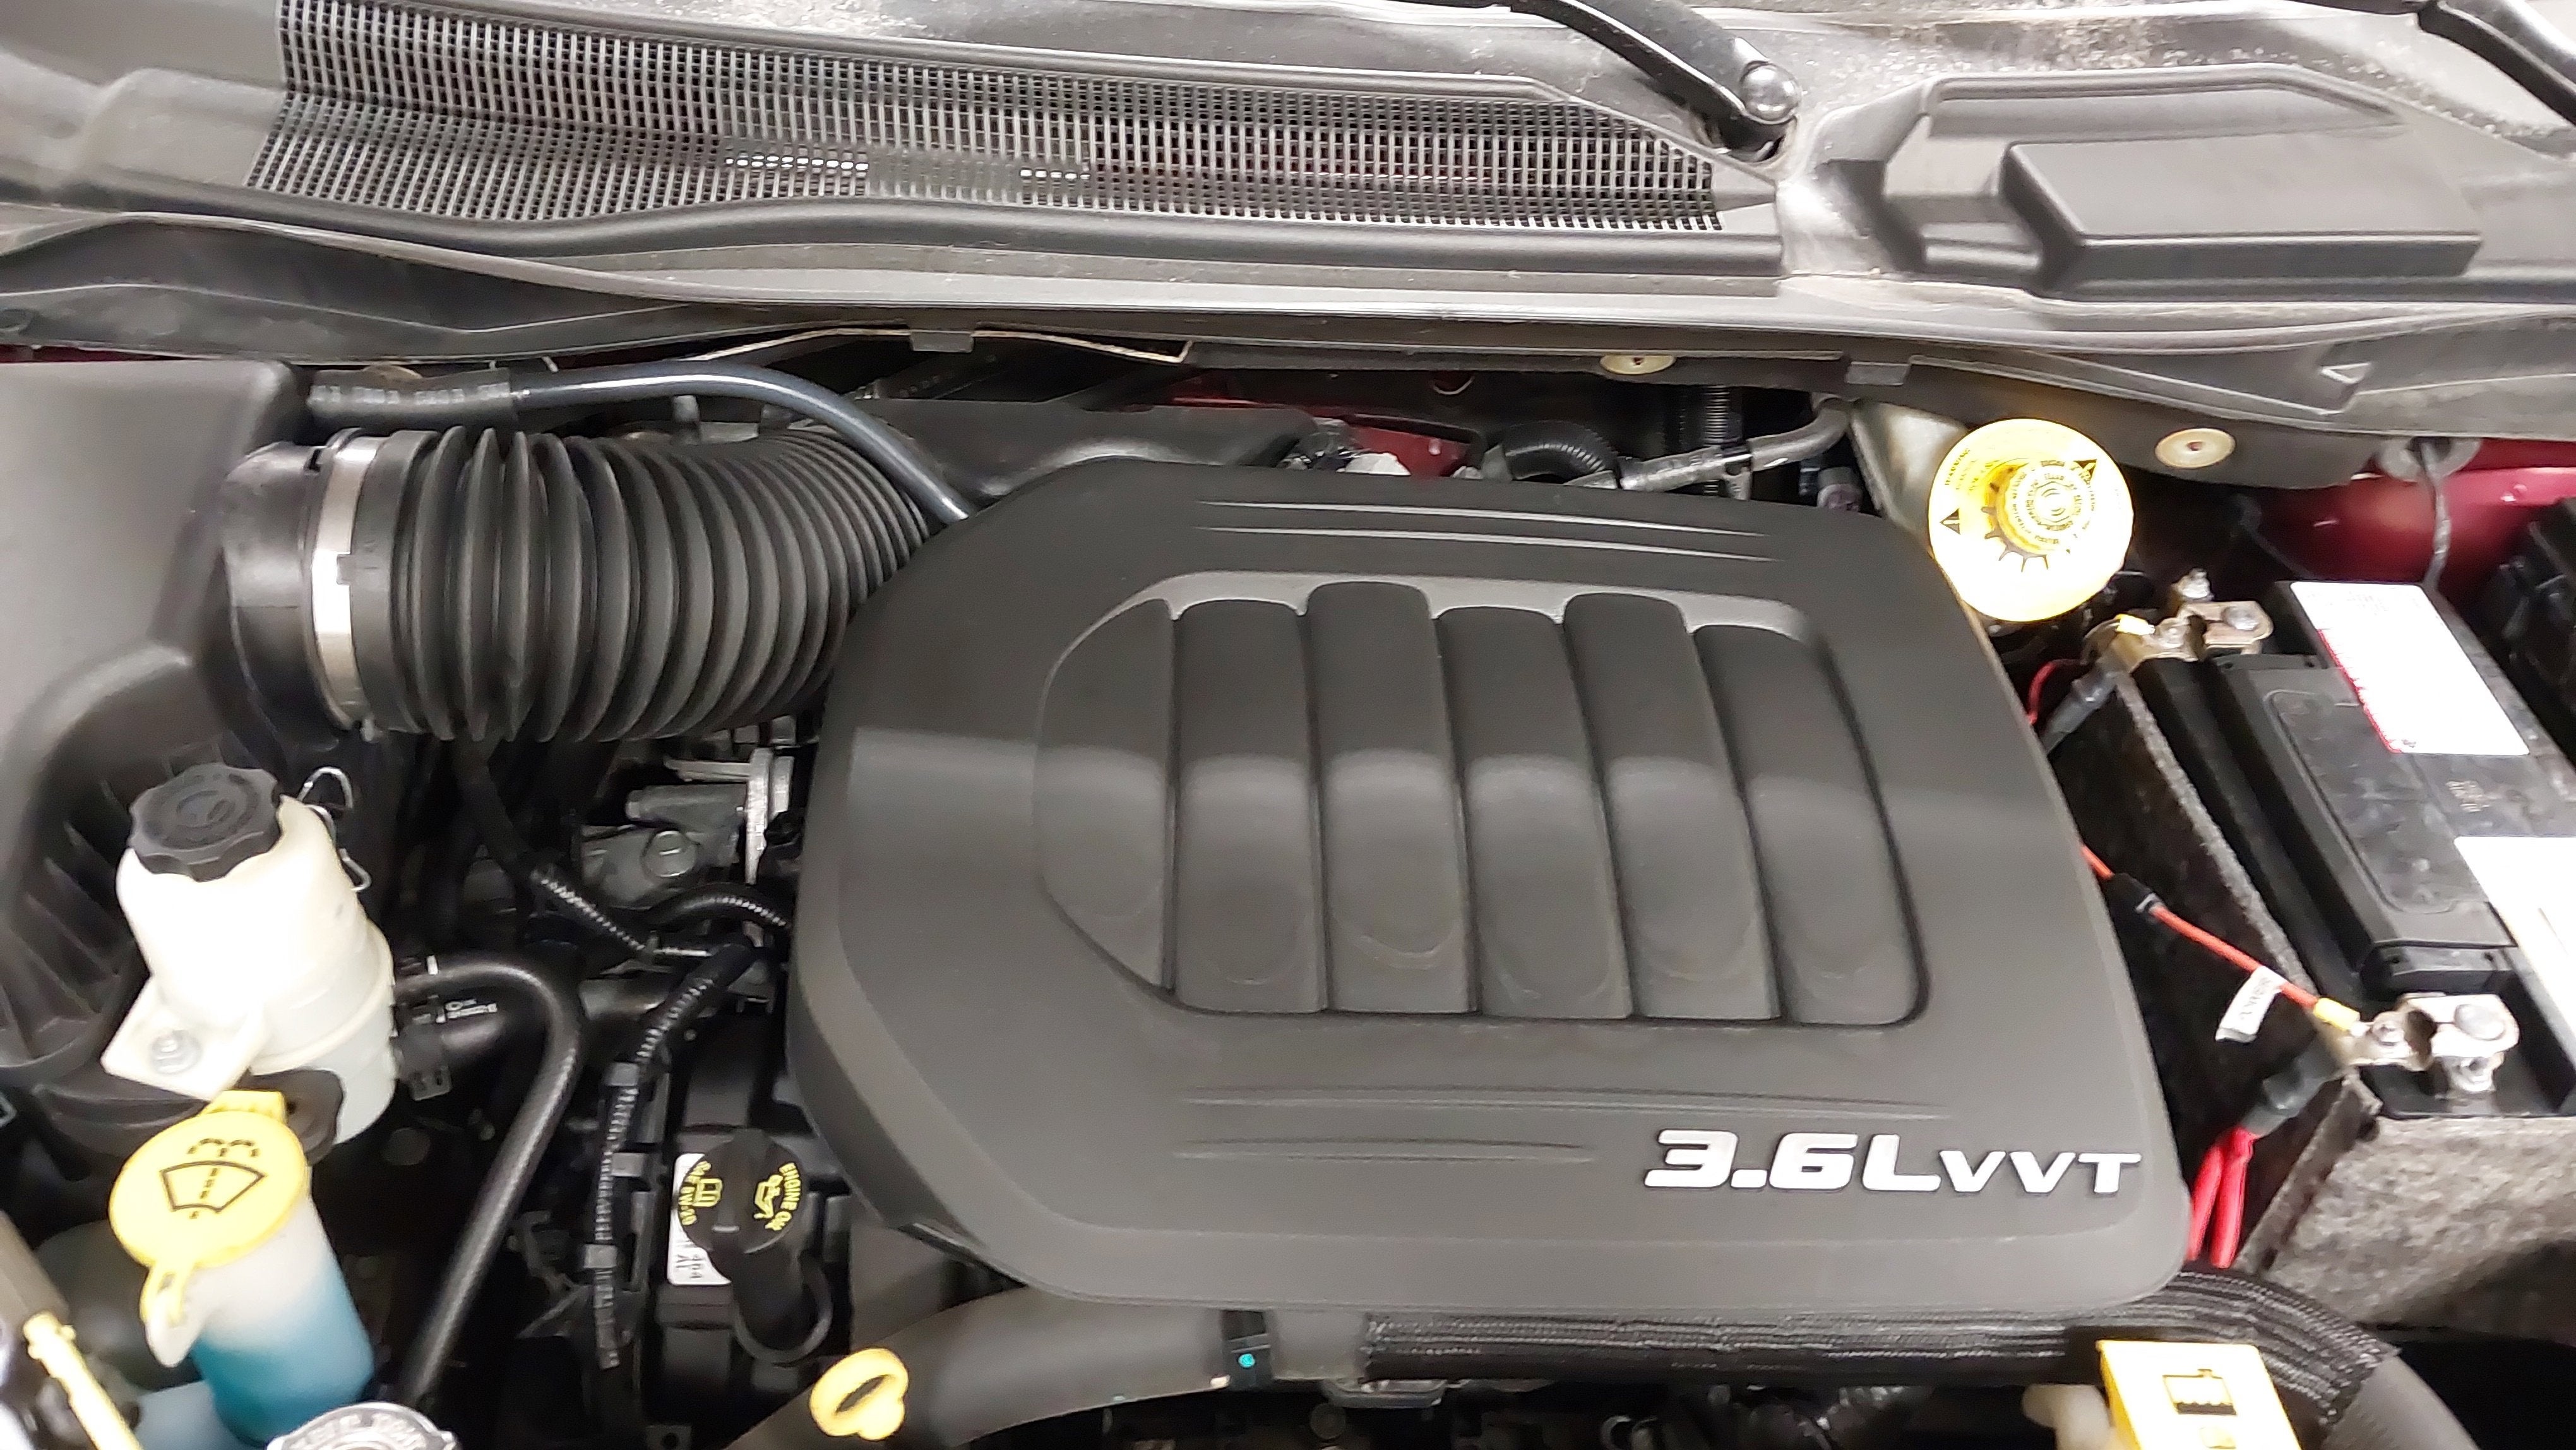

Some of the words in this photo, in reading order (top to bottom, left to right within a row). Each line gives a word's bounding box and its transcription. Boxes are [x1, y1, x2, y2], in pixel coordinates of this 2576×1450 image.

[778, 1161, 801, 1211] ENGINE
[1643, 1129, 1942, 1192] 3.6L
[1939, 1149, 2143, 1194] VVT
